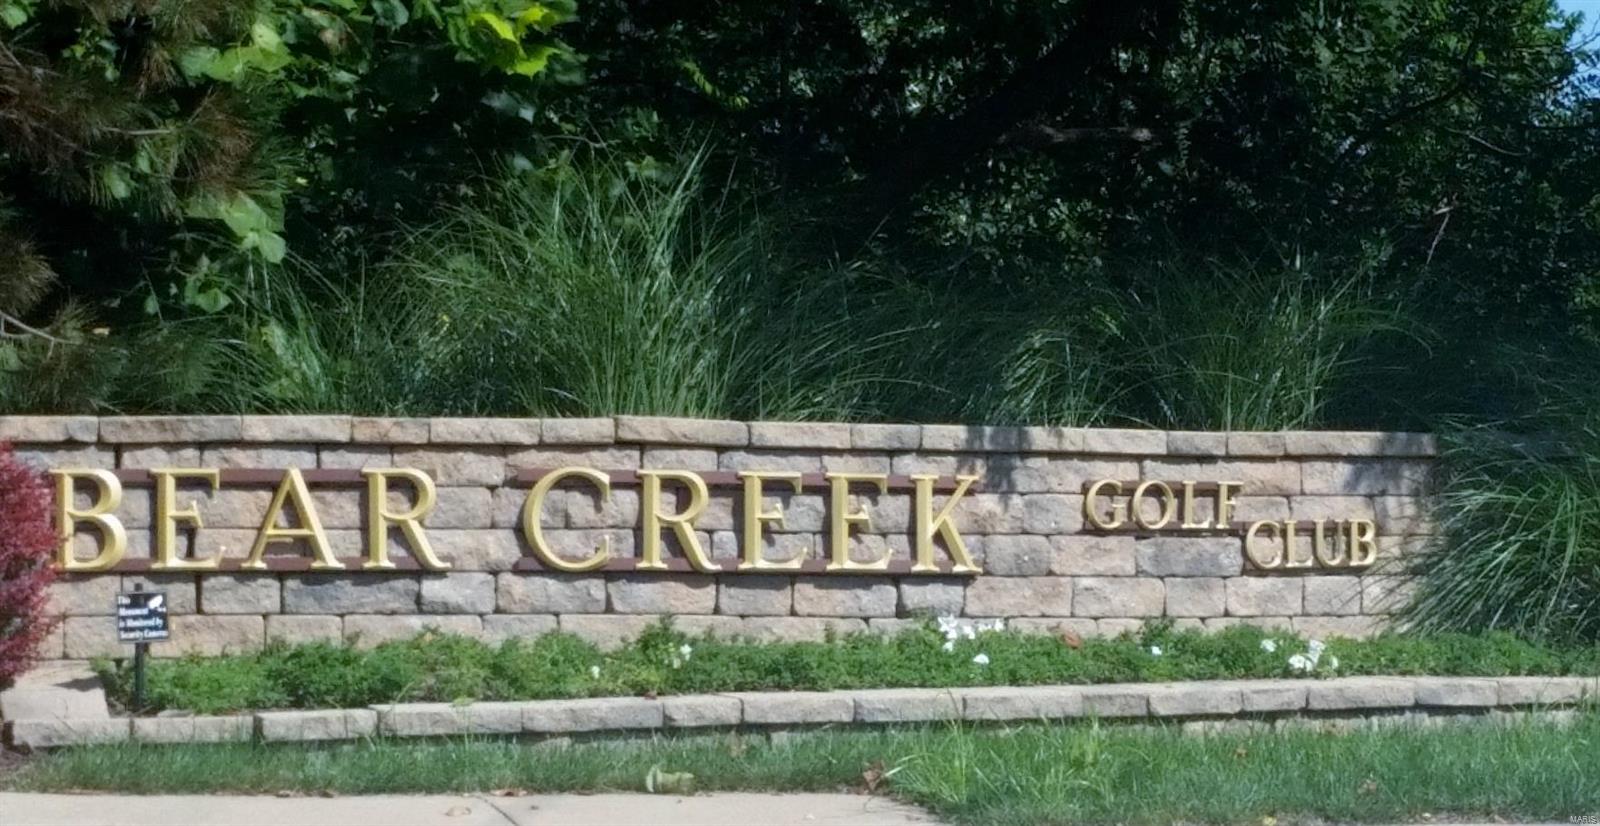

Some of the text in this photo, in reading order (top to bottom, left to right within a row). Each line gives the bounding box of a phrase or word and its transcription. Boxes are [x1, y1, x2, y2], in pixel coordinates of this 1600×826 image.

[48, 466, 982, 573] BEAR CREEK
[1085, 479, 1244, 530] GOLF
[1245, 518, 1378, 570] CLUB
